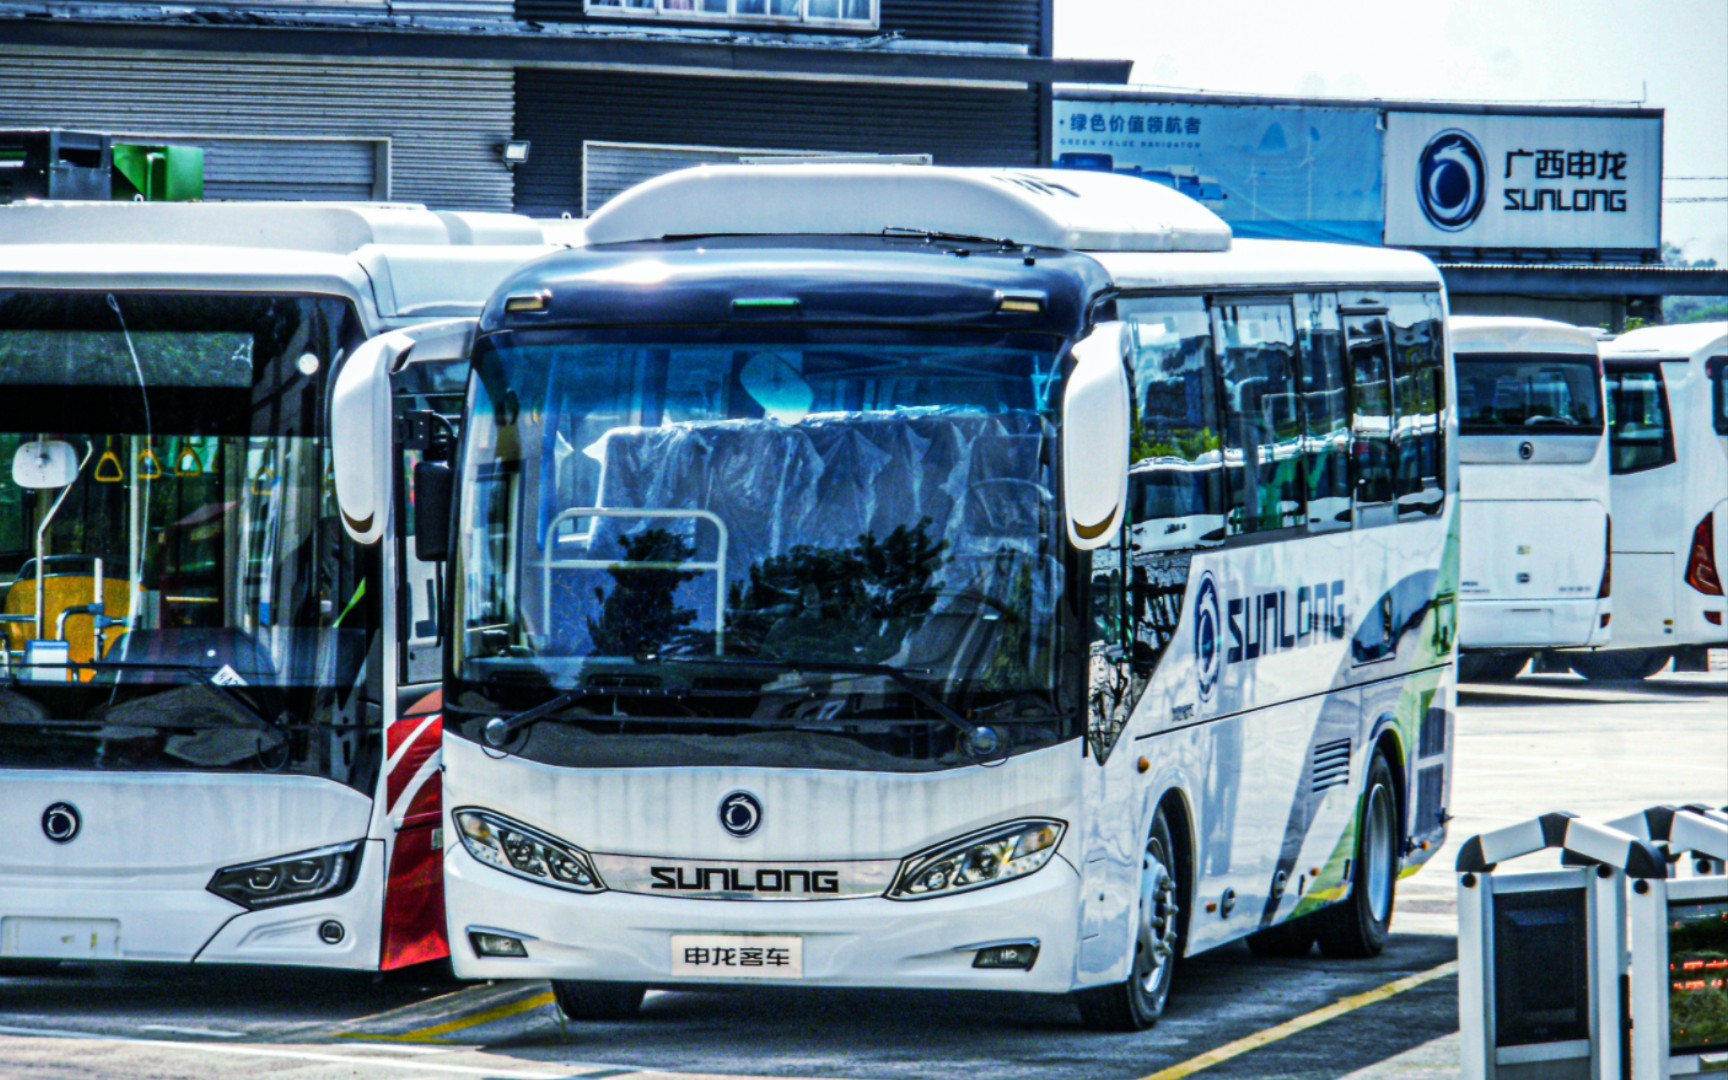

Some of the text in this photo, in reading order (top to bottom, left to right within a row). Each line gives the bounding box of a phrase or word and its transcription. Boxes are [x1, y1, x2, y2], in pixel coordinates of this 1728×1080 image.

[1070, 114, 1201, 134] 绿色价值领航者
[1504, 149, 1627, 180] 广西申龙
[1504, 188, 1627, 212] SUNLONG
[1227, 579, 1345, 665] SUNLONG
[651, 866, 839, 893] SUNLONG
[684, 947, 790, 967] 申龙客车
